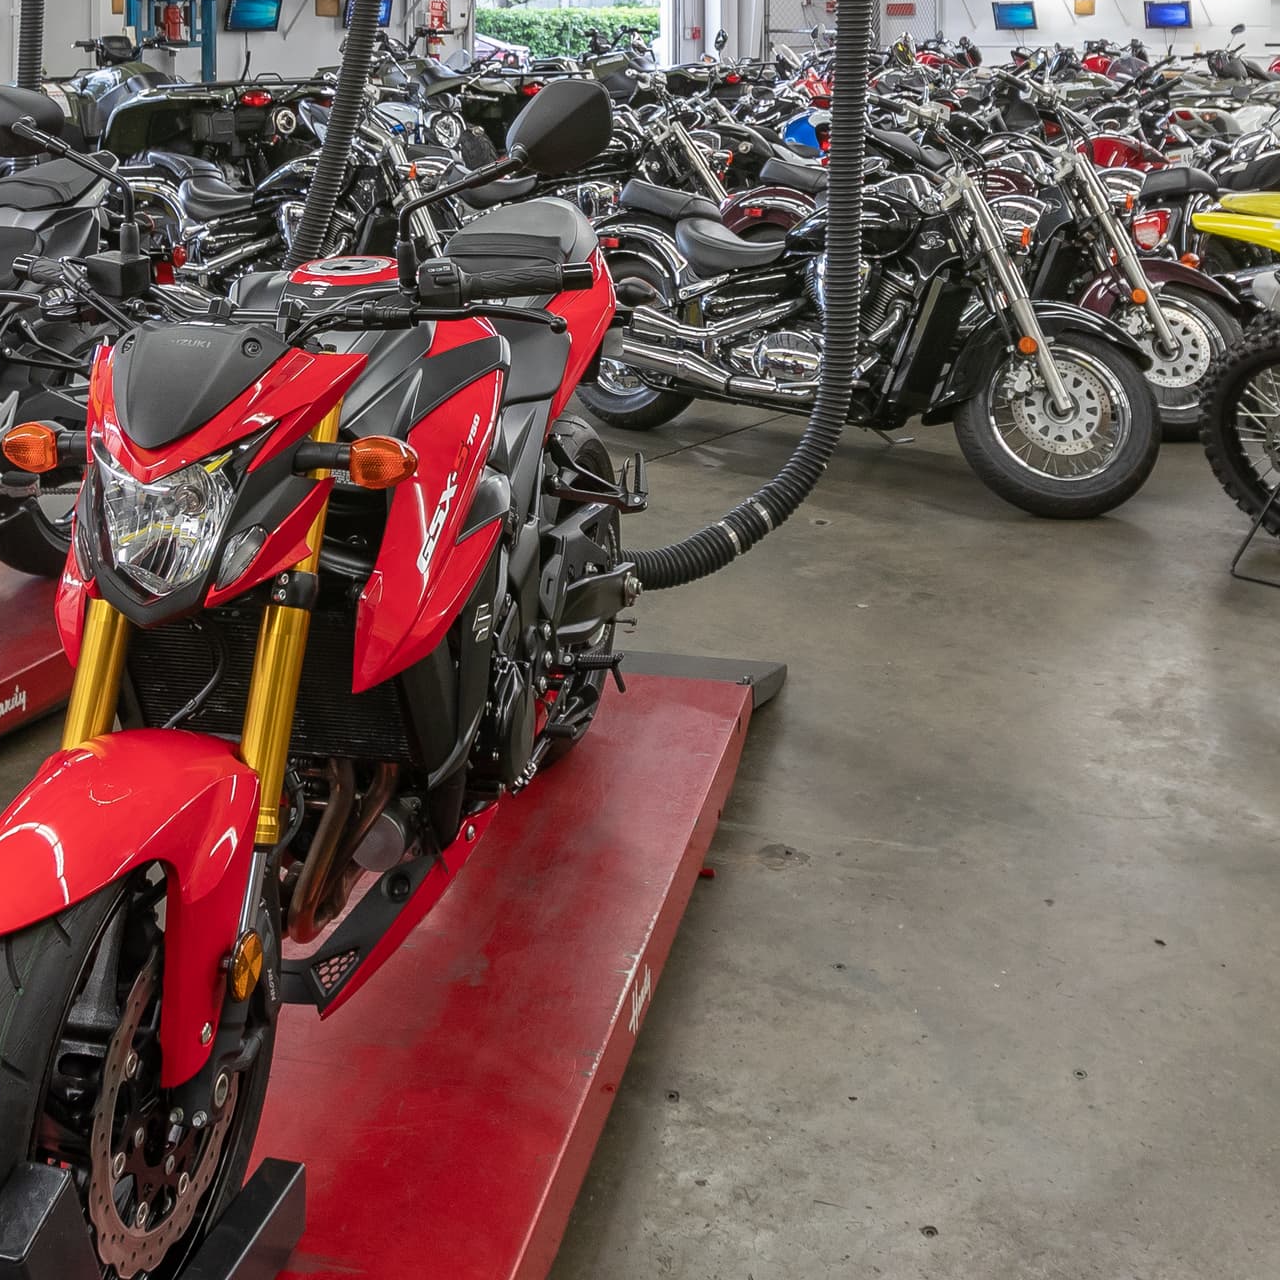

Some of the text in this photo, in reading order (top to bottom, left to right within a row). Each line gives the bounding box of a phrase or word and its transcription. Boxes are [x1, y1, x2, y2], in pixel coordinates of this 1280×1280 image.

[168, 338, 212, 349] ZUKI
[466, 413, 481, 446] 750
[628, 963, 651, 1036] Handy
